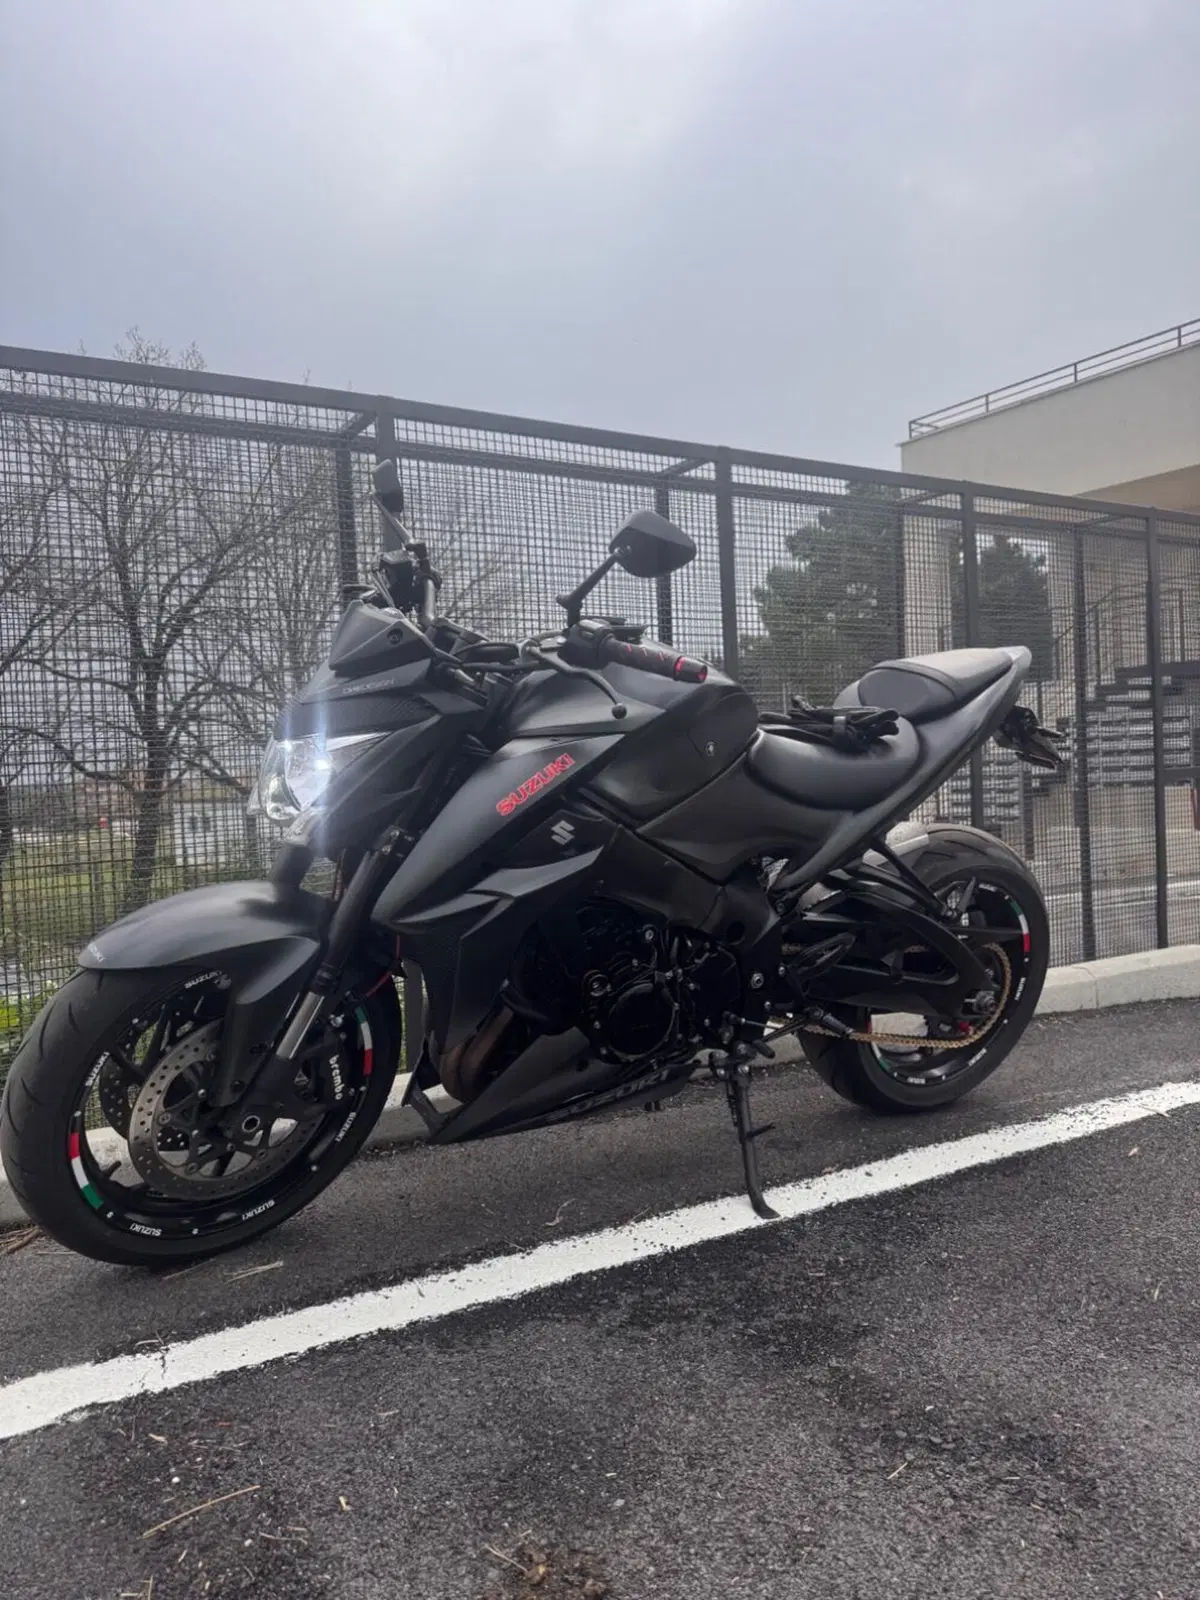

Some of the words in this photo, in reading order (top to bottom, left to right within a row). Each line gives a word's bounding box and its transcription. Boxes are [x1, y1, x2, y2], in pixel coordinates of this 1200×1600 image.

[496, 752, 575, 817] SUZUKI
[329, 1054, 345, 1100] brembo
[242, 1199, 275, 1221] SUZUKI
[129, 1222, 162, 1237] SUZUKI
